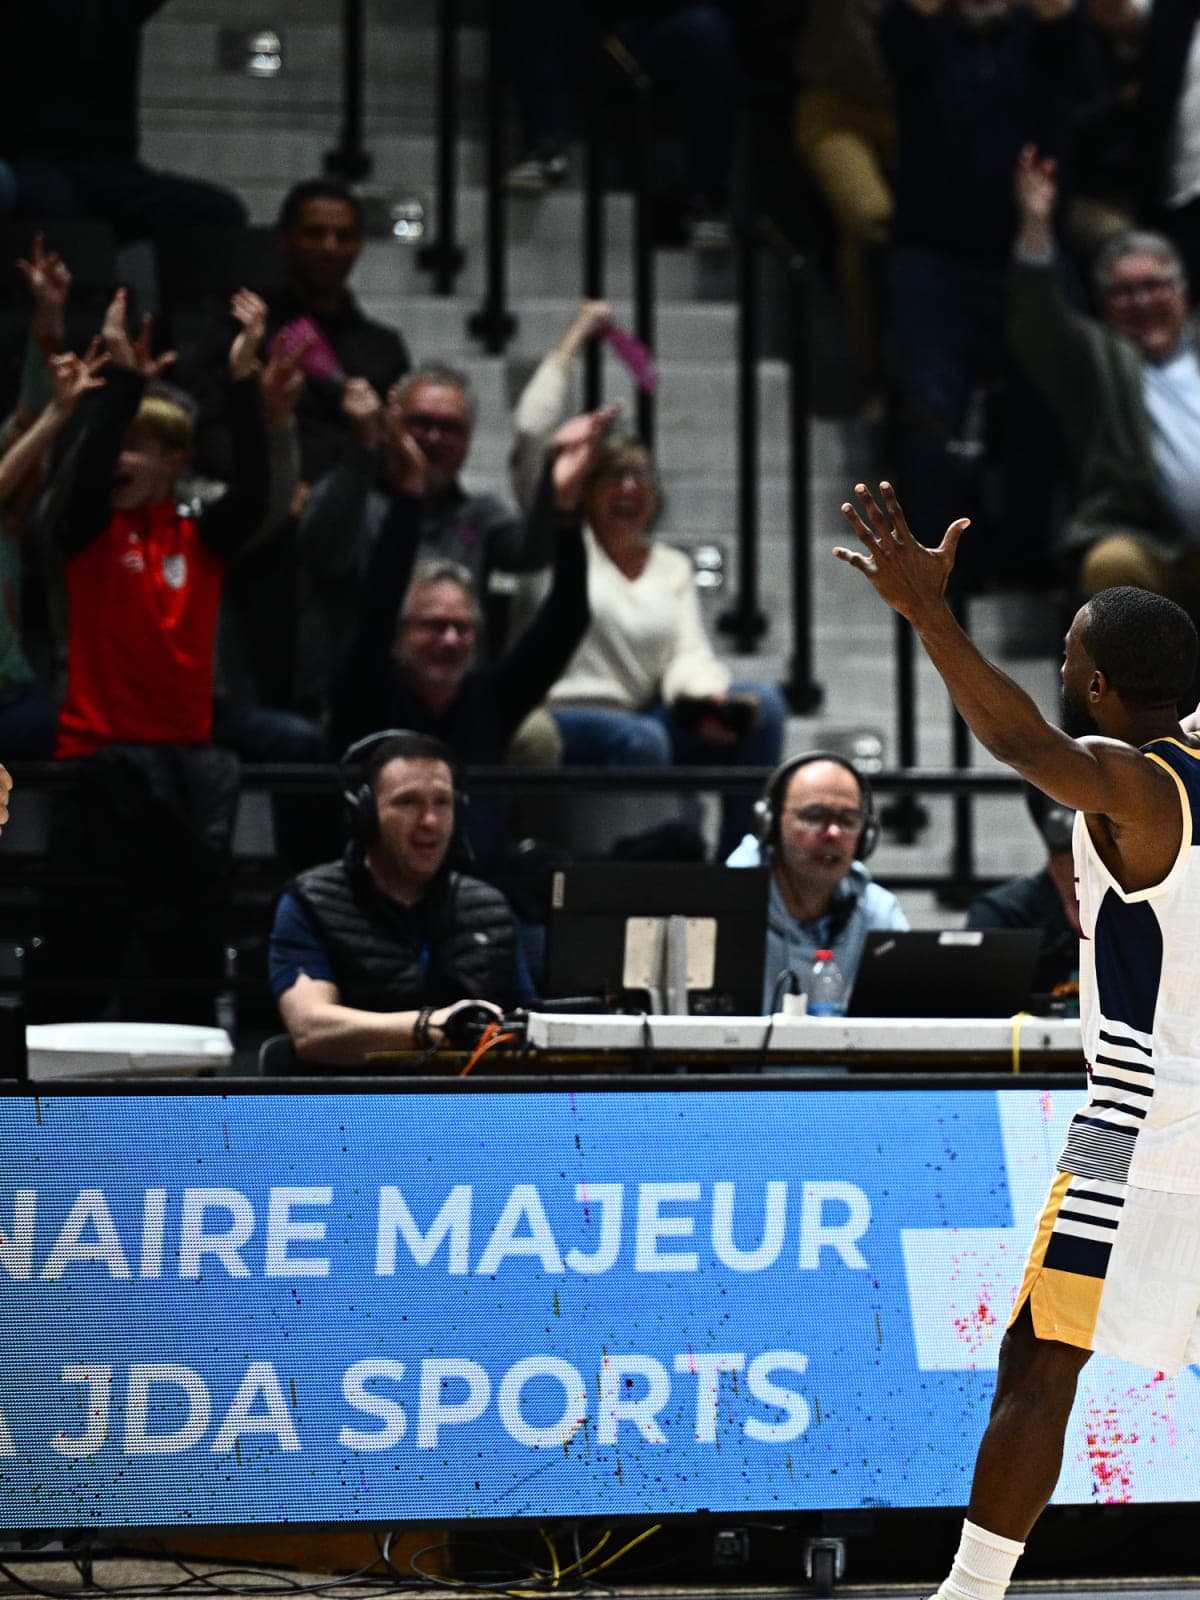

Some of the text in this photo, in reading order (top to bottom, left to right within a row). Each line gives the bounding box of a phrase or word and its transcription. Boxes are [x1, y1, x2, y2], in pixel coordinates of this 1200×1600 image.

[375, 1181, 873, 1277] MAJEUR
[49, 1361, 302, 1457] JDA
[337, 1350, 811, 1452] SPORTS
